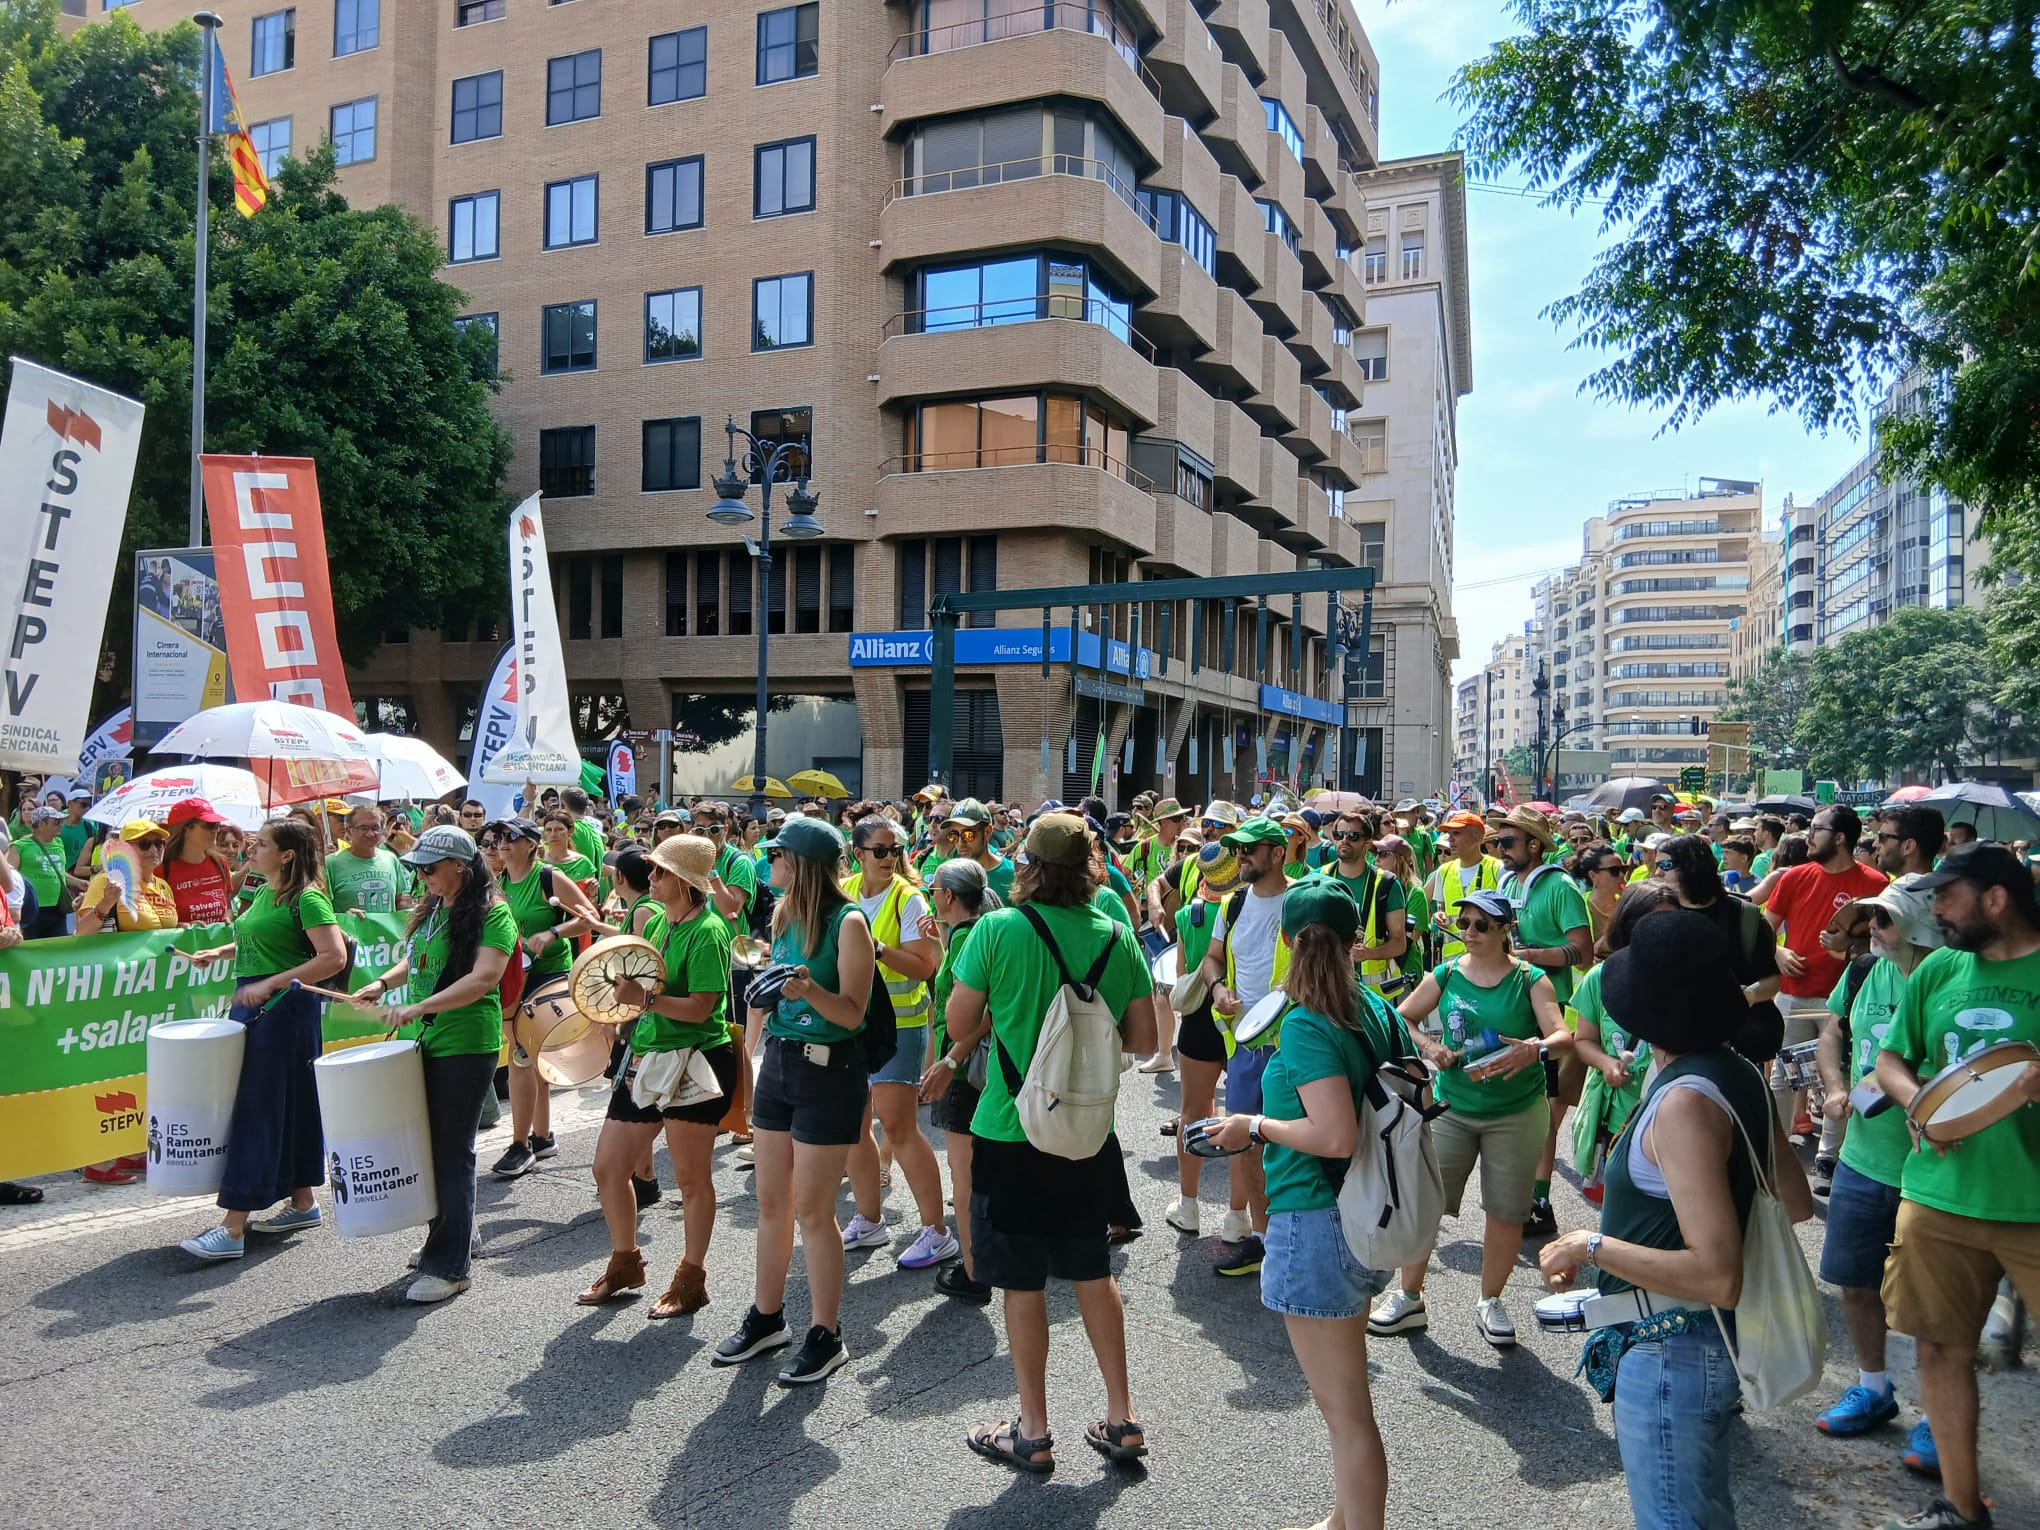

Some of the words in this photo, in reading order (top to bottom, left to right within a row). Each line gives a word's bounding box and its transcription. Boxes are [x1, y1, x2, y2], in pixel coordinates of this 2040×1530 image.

[5, 450, 82, 717] STEPV
[156, 641, 180, 649] Cimera
[851, 638, 920, 658] Allianz
[993, 644, 1021, 655] Allianz
[1022, 645, 1055, 657] Segus
[1, 724, 61, 742] SINDICAL
[0, 738, 59, 755] ENCIANA
[78, 736, 108, 773] EPV
[176, 880, 193, 890] UGT
[189, 900, 221, 912] Salvem
[26, 963, 103, 1007] N'HI
[113, 958, 157, 997] HA
[100, 1111, 145, 1134] STEPV
[166, 1124, 188, 1136] IES
[166, 1135, 211, 1147] Ramon
[166, 1144, 229, 1159] Muntaner
[350, 1155, 375, 1170] IES
[352, 1165, 401, 1183] Ramon
[353, 1171, 420, 1196] Muntaner
